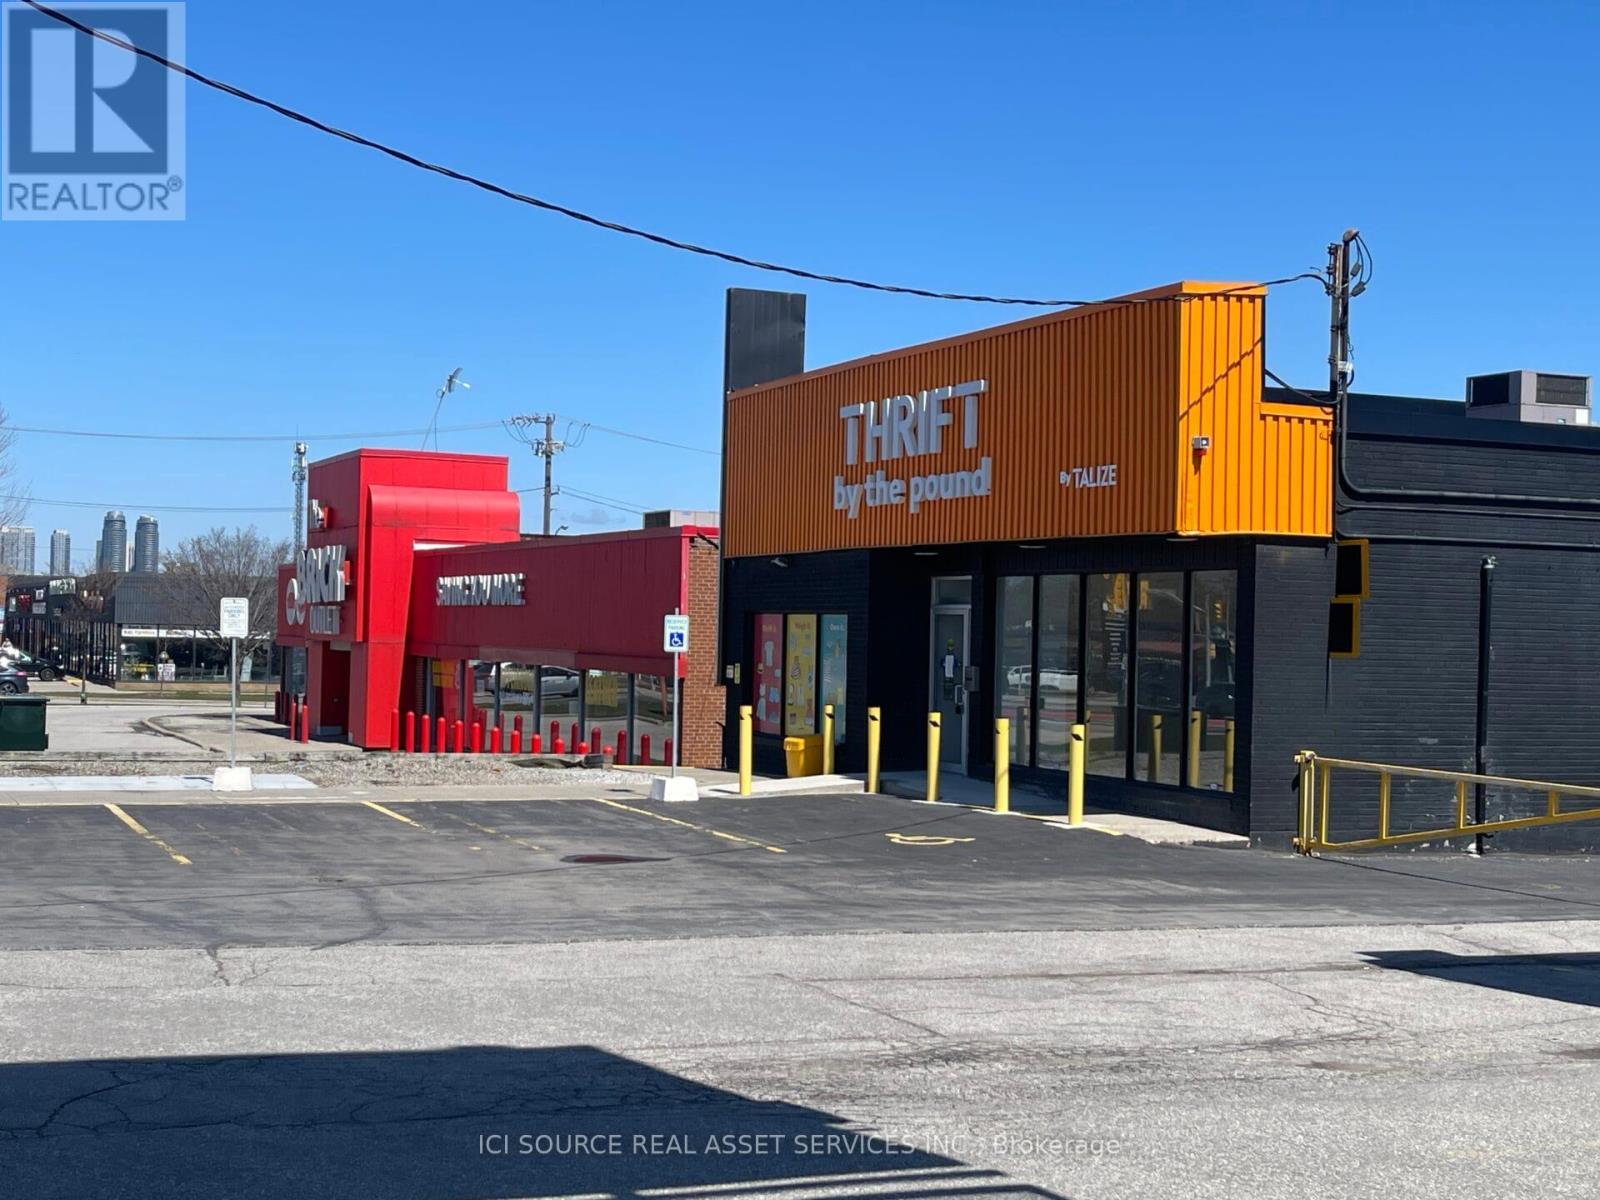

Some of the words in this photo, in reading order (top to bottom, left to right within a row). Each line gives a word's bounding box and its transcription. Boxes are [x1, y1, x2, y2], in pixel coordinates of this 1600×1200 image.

[840, 378, 990, 465] THRIFT
[834, 472, 863, 520] by
[864, 470, 905, 508] the
[909, 456, 993, 514] pound
[1072, 464, 1118, 490] TALIZE
[297, 544, 347, 604] BRICK
